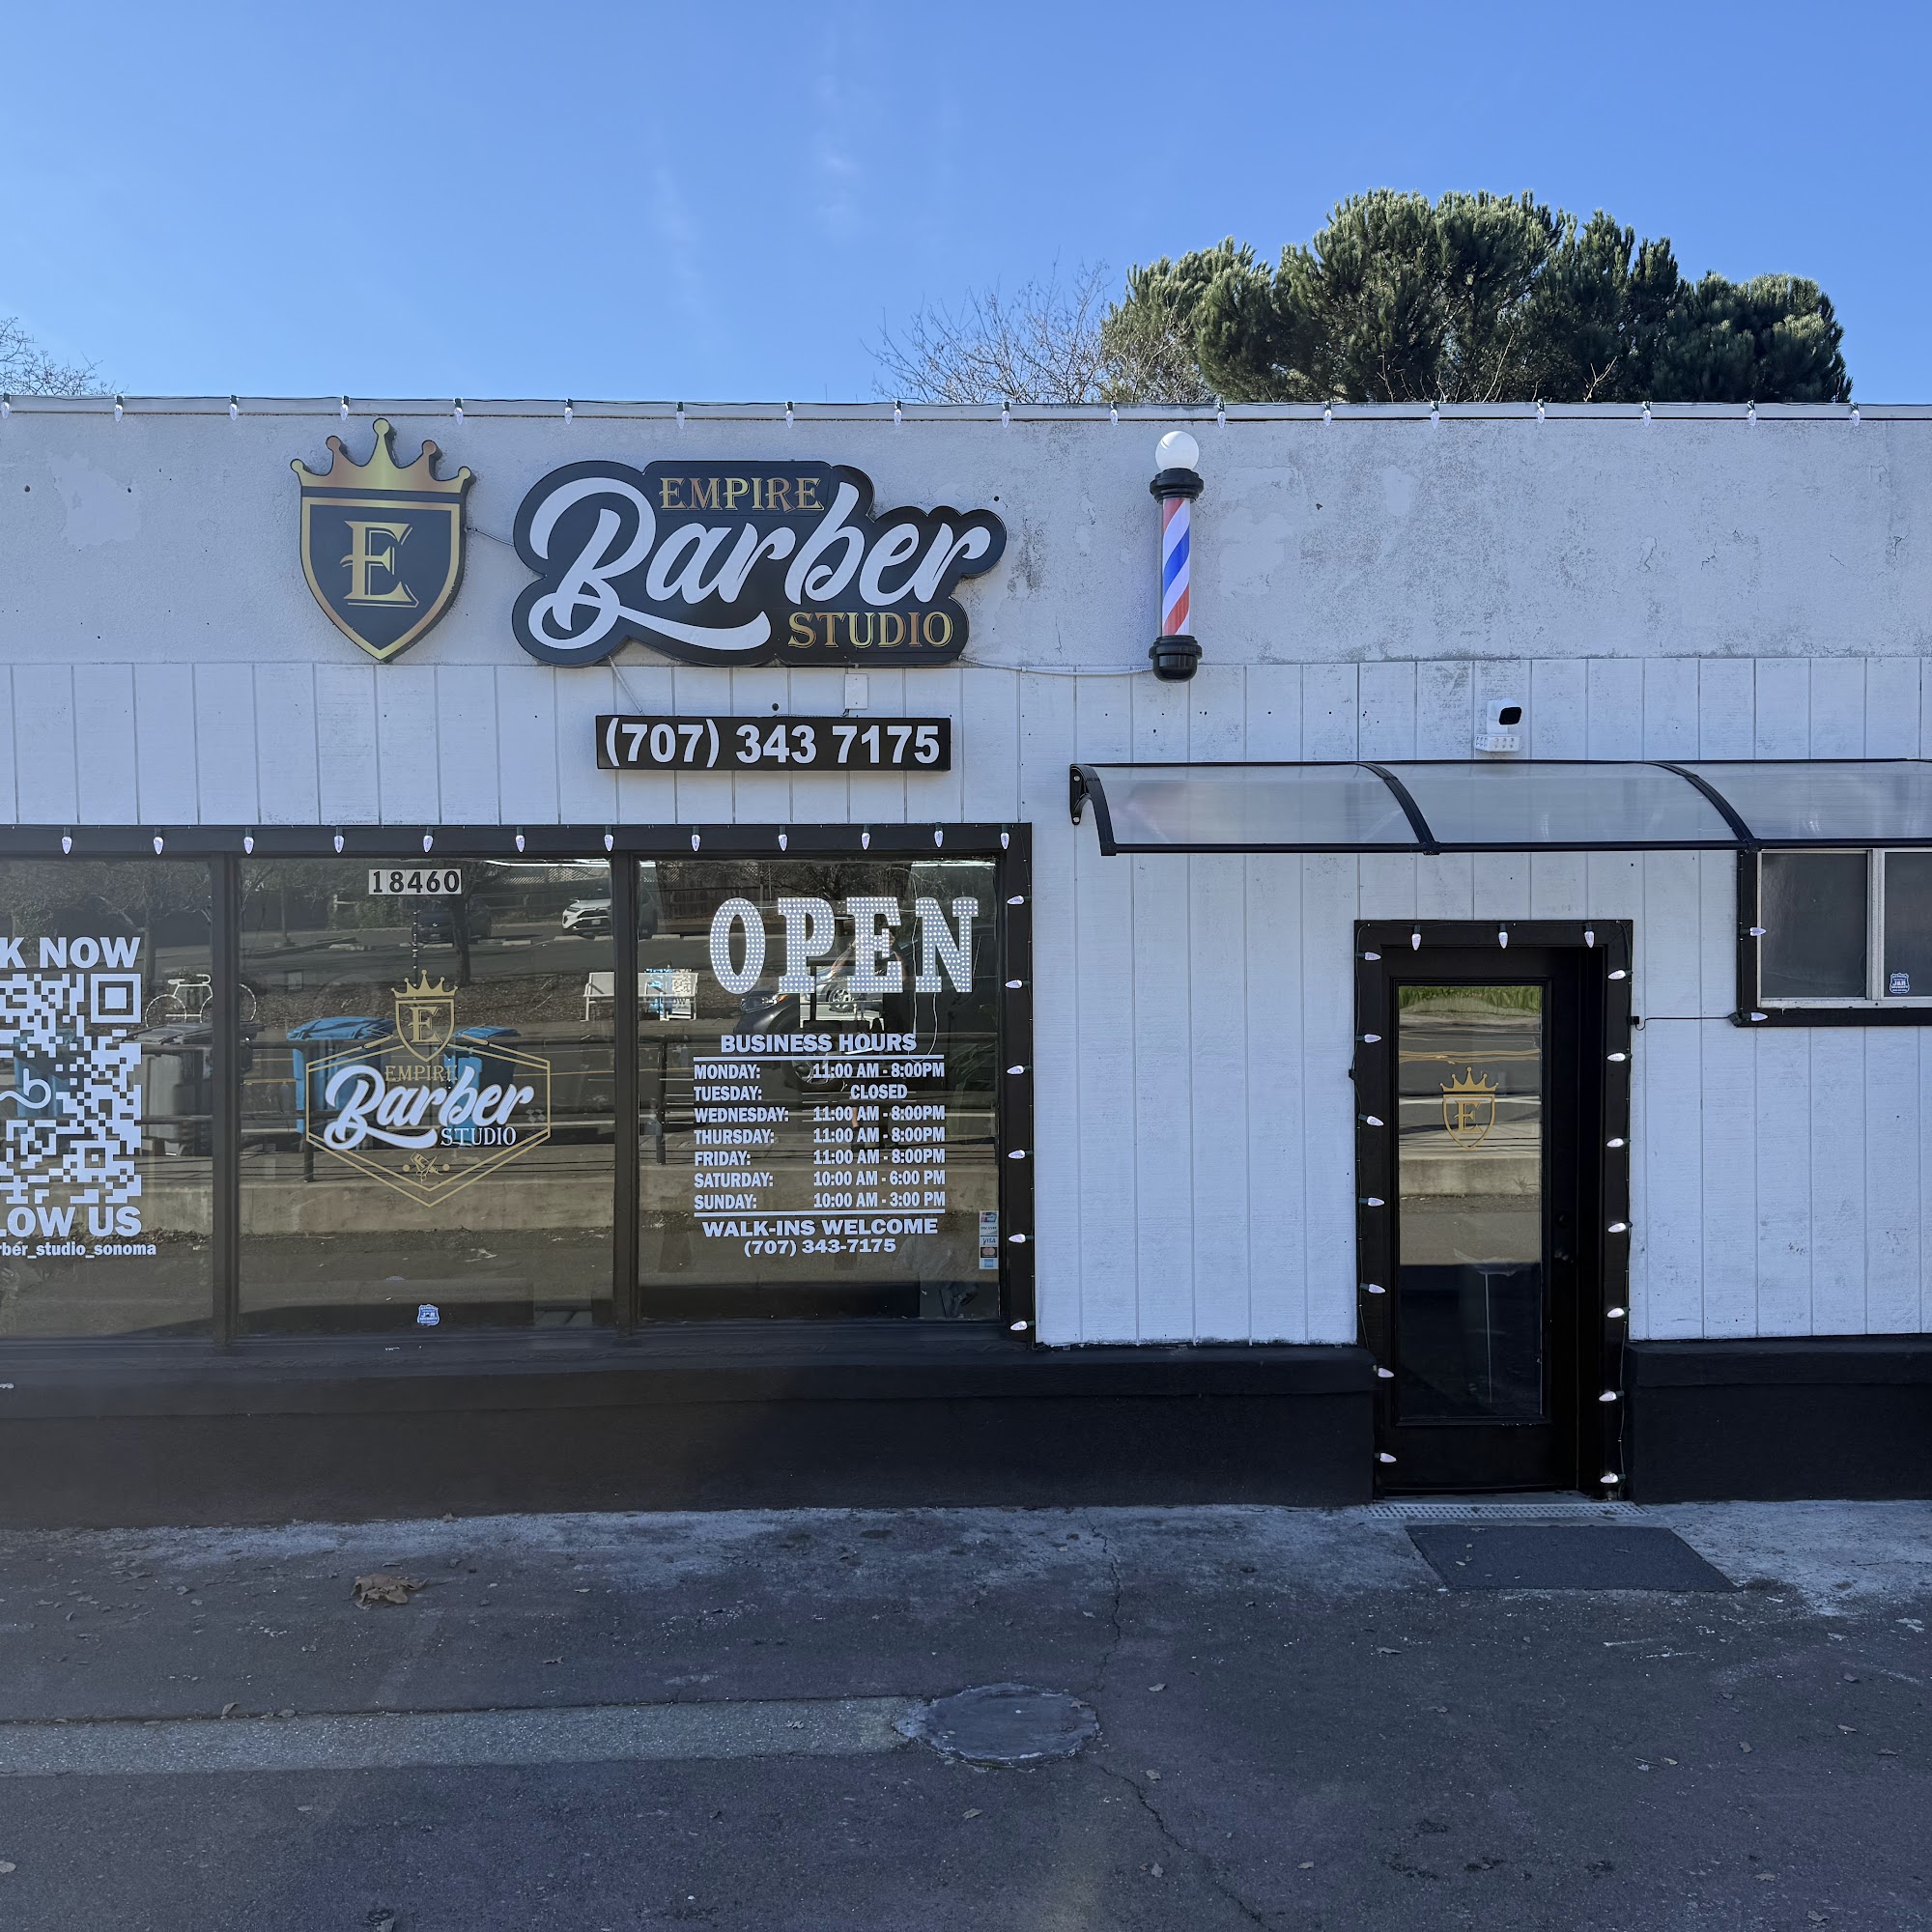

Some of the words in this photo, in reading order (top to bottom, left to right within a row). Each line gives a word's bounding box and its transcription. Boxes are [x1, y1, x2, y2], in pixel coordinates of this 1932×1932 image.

[659, 477, 825, 512] EMPIRE
[340, 521, 419, 608] E
[528, 477, 991, 650] Barber
[787, 611, 954, 648] STUDIO
[606, 718, 720, 767] (707)
[735, 724, 817, 763] 343
[832, 725, 940, 764] 7175
[373, 870, 459, 893] 18460
[40, 936, 141, 968] NOW
[710, 896, 979, 994] OPEN
[408, 1006, 443, 1045] E
[721, 1034, 833, 1053] BUSINESS
[838, 1034, 917, 1052] HOURS
[384, 1065, 459, 1082] EMPIRE
[695, 1064, 760, 1080] MONDAY:
[813, 1064, 853, 1078] 11:00
[857, 1063, 879, 1077] AM
[891, 1063, 945, 1077] 8:00PM
[694, 1086, 762, 1101] TUESDAY:
[850, 1084, 908, 1099] CLOSED
[324, 1065, 534, 1150] Barber
[695, 1107, 789, 1123] WEDNESDAY:
[813, 1106, 853, 1122] 11:00
[857, 1106, 879, 1121] AM
[891, 1105, 946, 1121] 8:00PM
[1453, 1100, 1484, 1134] E
[440, 1126, 517, 1146] STUDIO
[695, 1128, 774, 1145] THURSDAY:
[813, 1128, 853, 1143] 11:00
[857, 1127, 879, 1142] AM
[892, 1126, 946, 1142] 8:00PM
[695, 1151, 751, 1167] FRIDAY:
[813, 1150, 854, 1164] 11:00
[857, 1150, 879, 1164] AM
[891, 1149, 946, 1163] 8:00PM
[695, 1172, 774, 1188] SATURDAY:
[813, 1171, 853, 1186] 10:00
[856, 1171, 878, 1185] AM
[890, 1170, 920, 1185] 6:00
[923, 1170, 946, 1184] PM
[695, 1194, 757, 1210] SUNDAY:
[813, 1193, 853, 1208] 10:00
[856, 1192, 878, 1207] AM
[890, 1191, 920, 1207] 3:00
[923, 1191, 946, 1207] PM
[0, 1206, 75, 1237] OW
[89, 1206, 142, 1237] US
[702, 1220, 816, 1236] WALK-INS
[821, 1218, 938, 1236] WELCOME
[0, 1241, 156, 1259] ber_studio_sonoma
[744, 1239, 797, 1257] (707)
[801, 1237, 896, 1254] 343-7175
